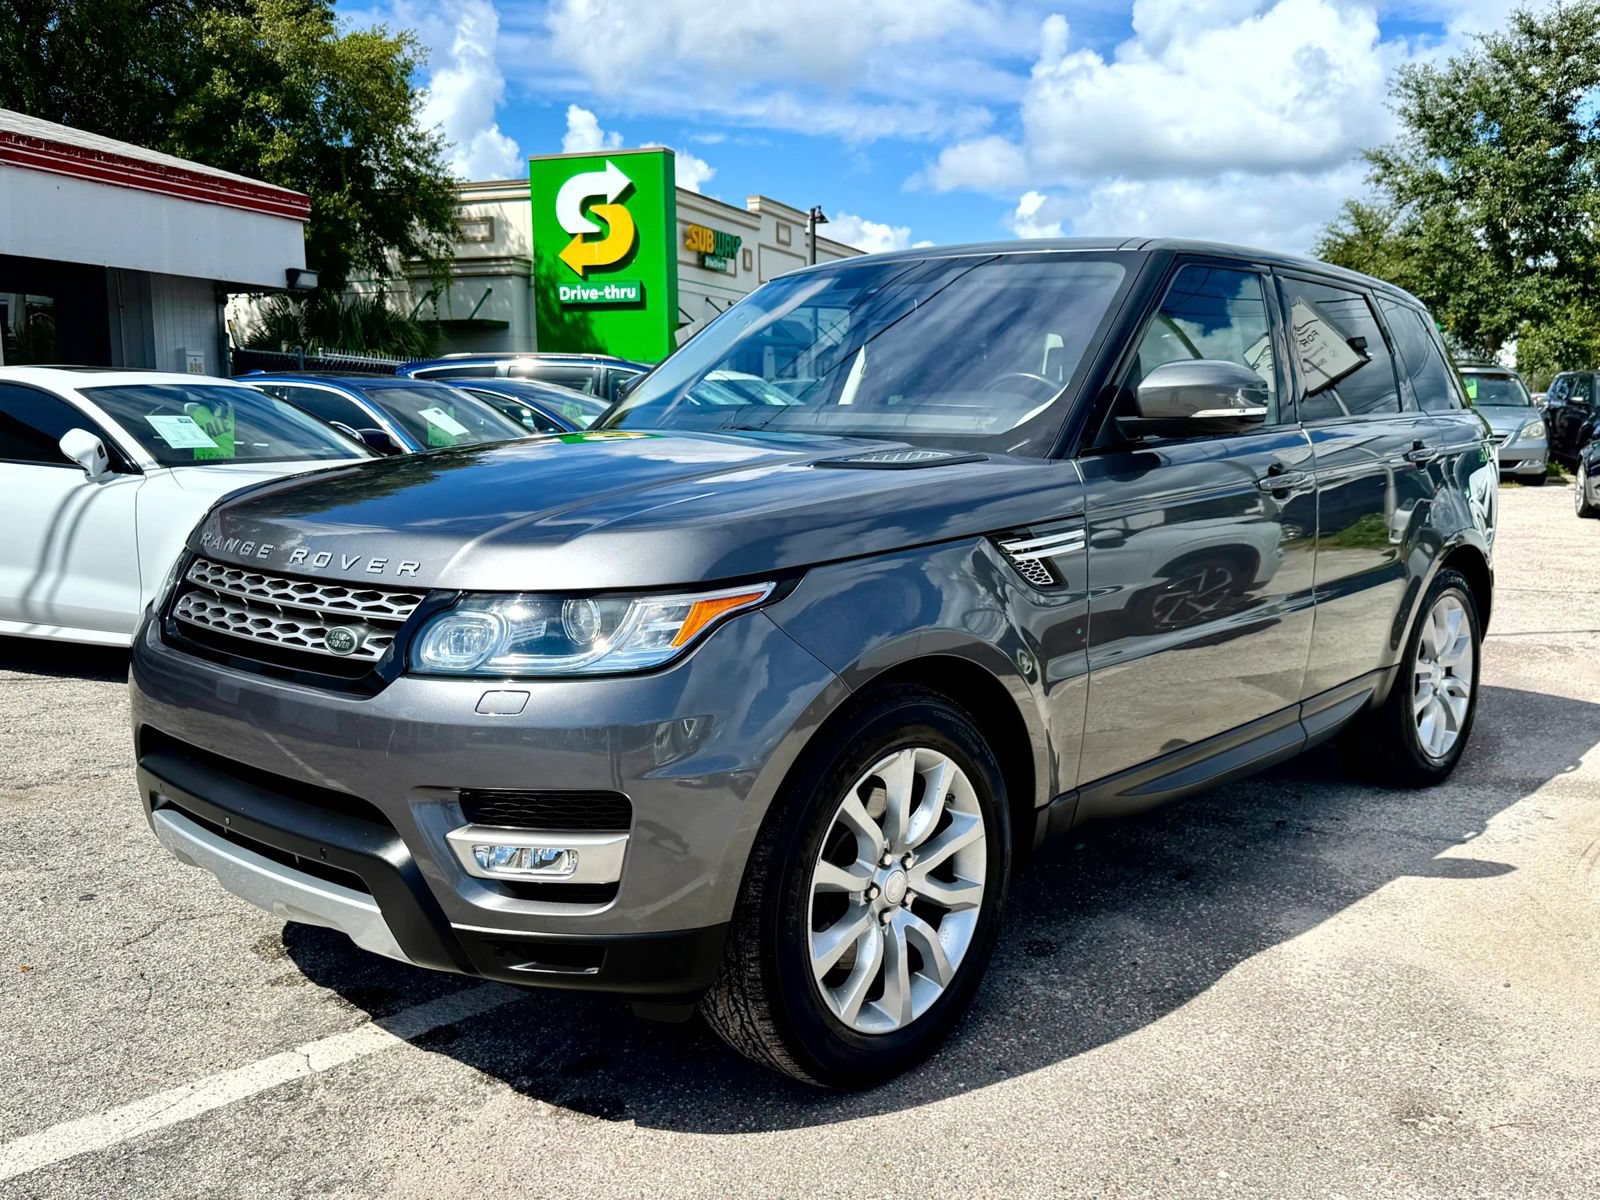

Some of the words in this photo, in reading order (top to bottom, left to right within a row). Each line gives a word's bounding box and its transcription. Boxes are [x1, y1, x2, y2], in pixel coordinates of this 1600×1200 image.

[684, 224, 742, 259] SUBWAY
[559, 284, 636, 301] Drive-thru
[200, 532, 274, 559] RANGE
[289, 548, 421, 577] ROVER
